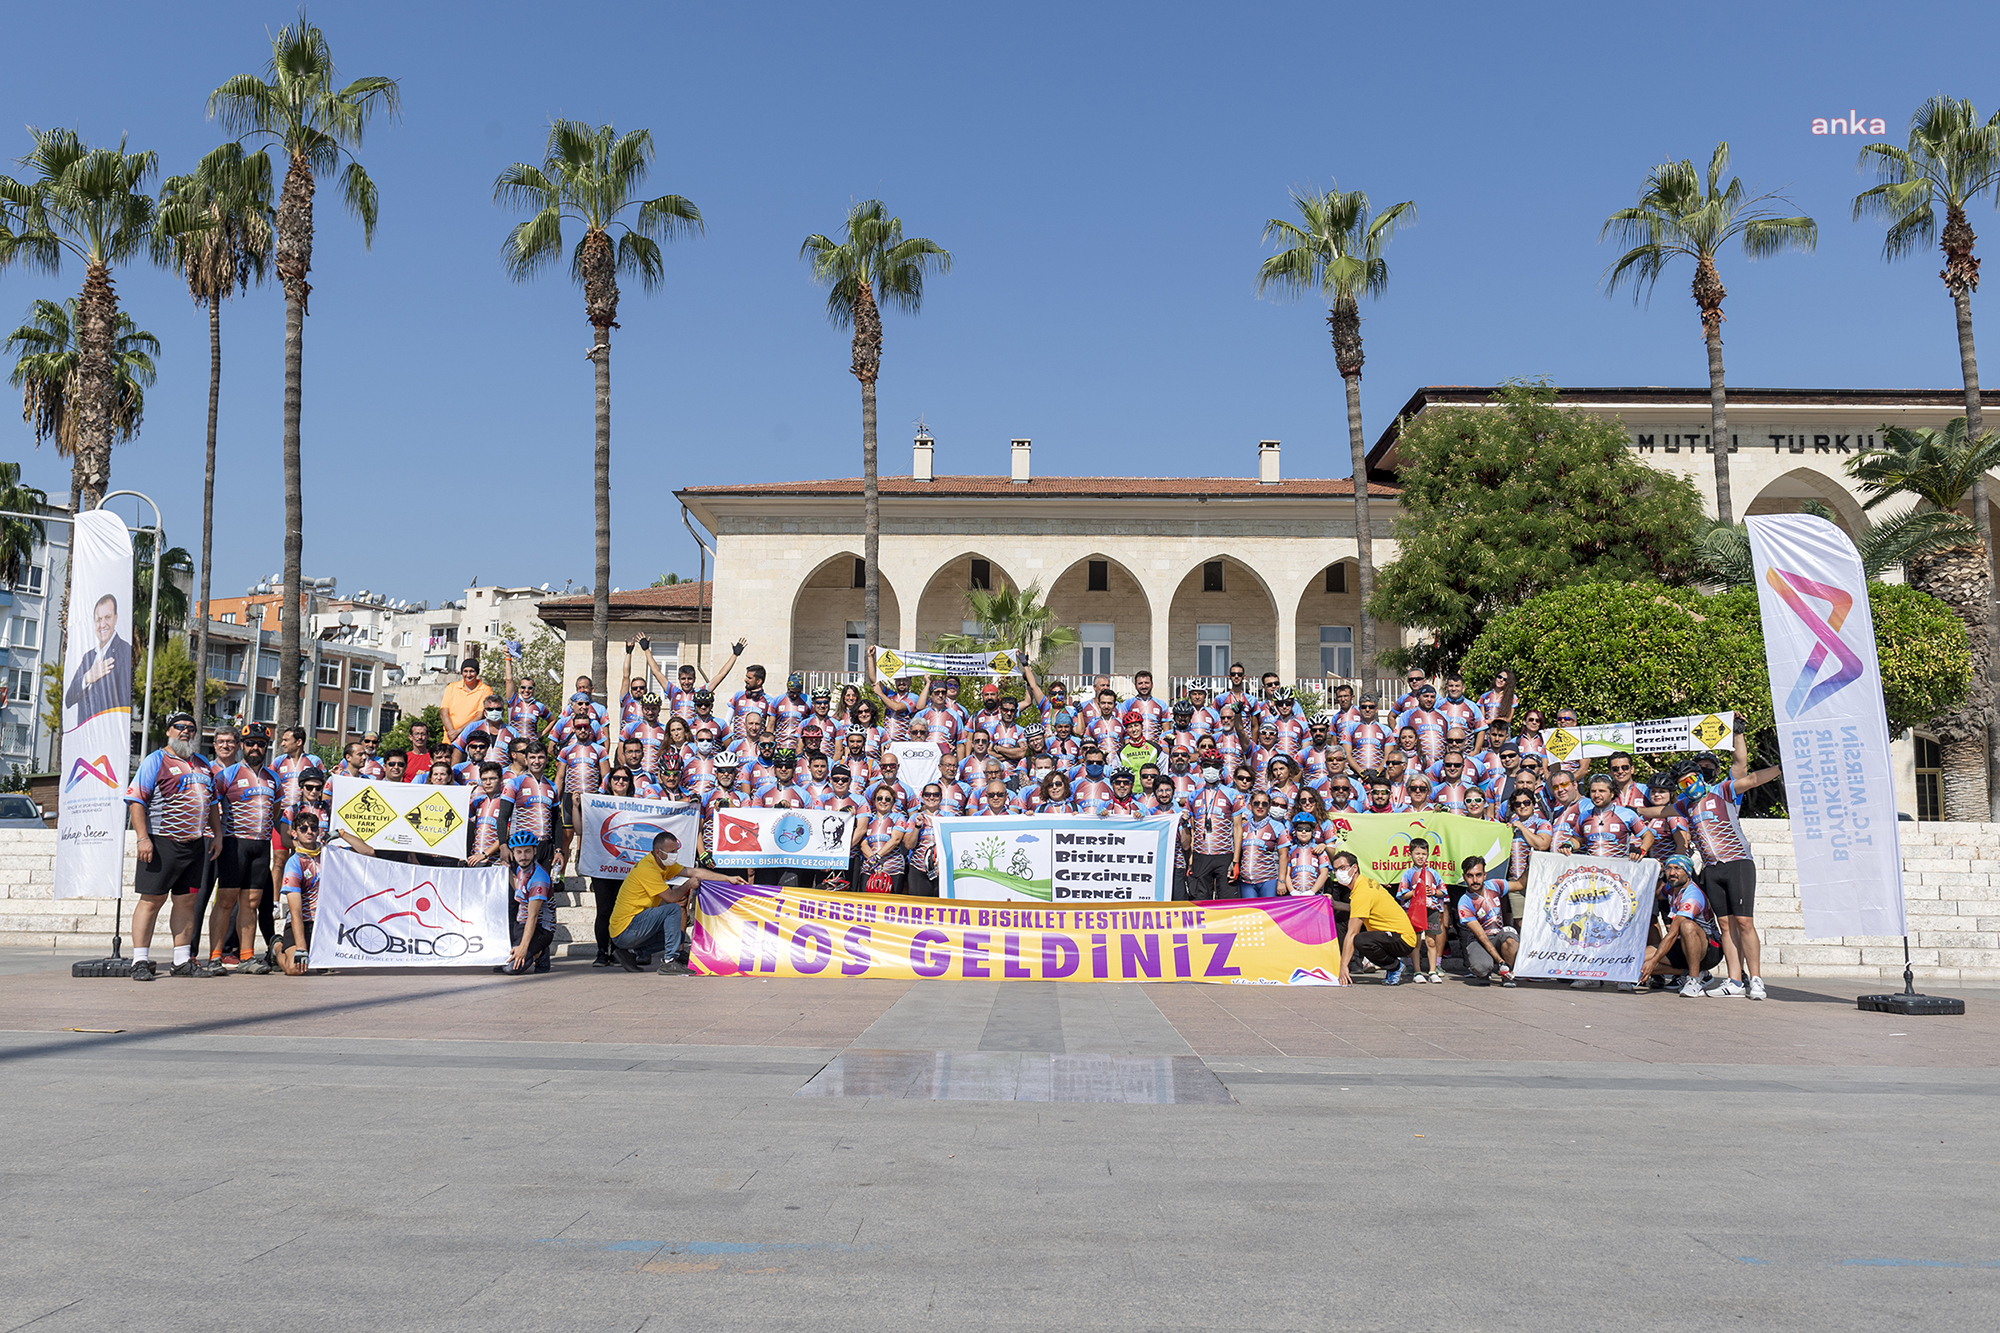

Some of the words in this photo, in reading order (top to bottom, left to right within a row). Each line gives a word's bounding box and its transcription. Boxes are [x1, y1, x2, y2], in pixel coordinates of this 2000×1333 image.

[1638, 434, 1738, 454] MUTLU
[1126, 750, 1151, 758] MALATYA
[424, 804, 445, 813] YOLU
[618, 801, 654, 814] BİSİKLET
[61, 826, 82, 845] Vahap
[356, 826, 376, 834] EDİN!
[1055, 832, 1126, 846] MERSİN
[1055, 850, 1154, 865] BİSİKLETLİ
[1389, 845, 1441, 858] ARA
[717, 856, 756, 866] DÖRTYOL
[756, 856, 799, 866] BİSİKLETLİ
[1372, 859, 1412, 871] BİSİKLET
[600, 864, 619, 873] SPOR
[1055, 869, 1153, 883] GEZGİNLER
[1055, 886, 1133, 900] DERNEĞİ
[1569, 889, 1609, 903] URBİT
[884, 904, 971, 926] CARETTA
[978, 908, 1068, 929] BİSİKLET
[910, 928, 1242, 978] GELDİNİZ
